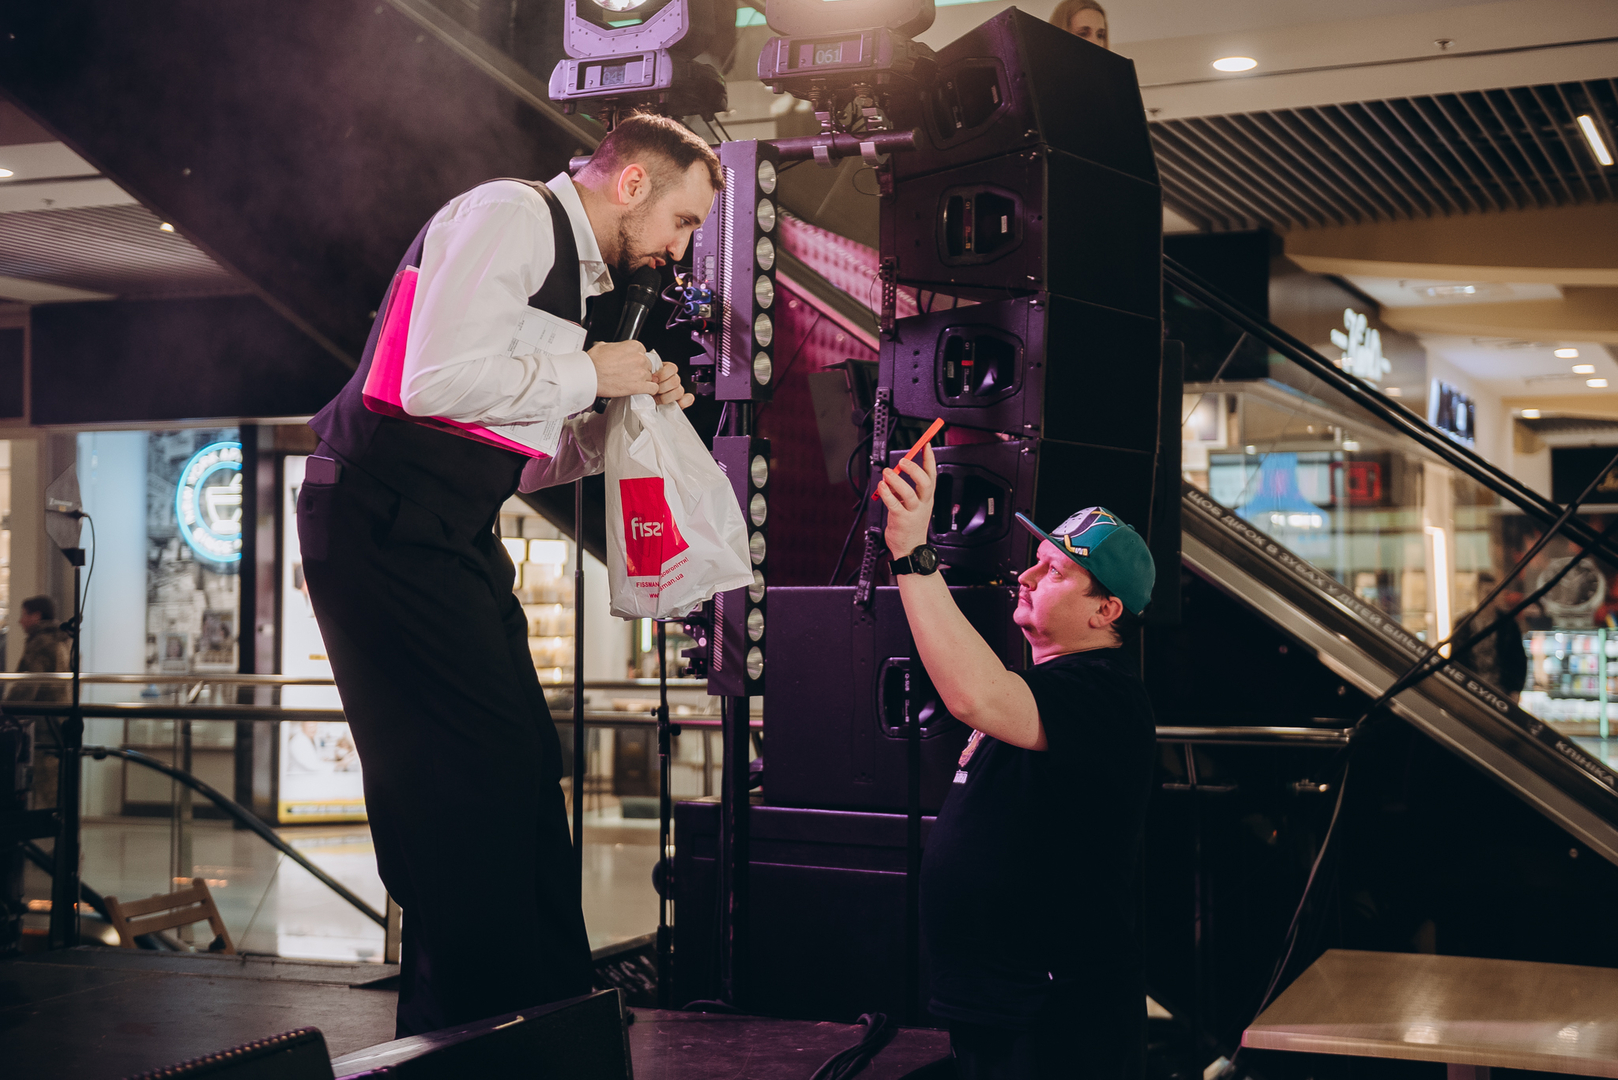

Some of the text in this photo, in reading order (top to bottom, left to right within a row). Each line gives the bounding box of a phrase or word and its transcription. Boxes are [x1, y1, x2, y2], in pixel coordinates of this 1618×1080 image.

[815, 49, 841, 64] 061
[1187, 490, 1223, 518] ЩОБ
[1220, 514, 1268, 547] ДІРОК
[1265, 544, 1279, 557] В
[1278, 551, 1329, 587] ЗУБАХ
[1327, 584, 1338, 596] У
[1335, 593, 1382, 627] ДІТЕЙ
[1443, 664, 1466, 682] НЕ
[1466, 678, 1509, 713] БУЛО
